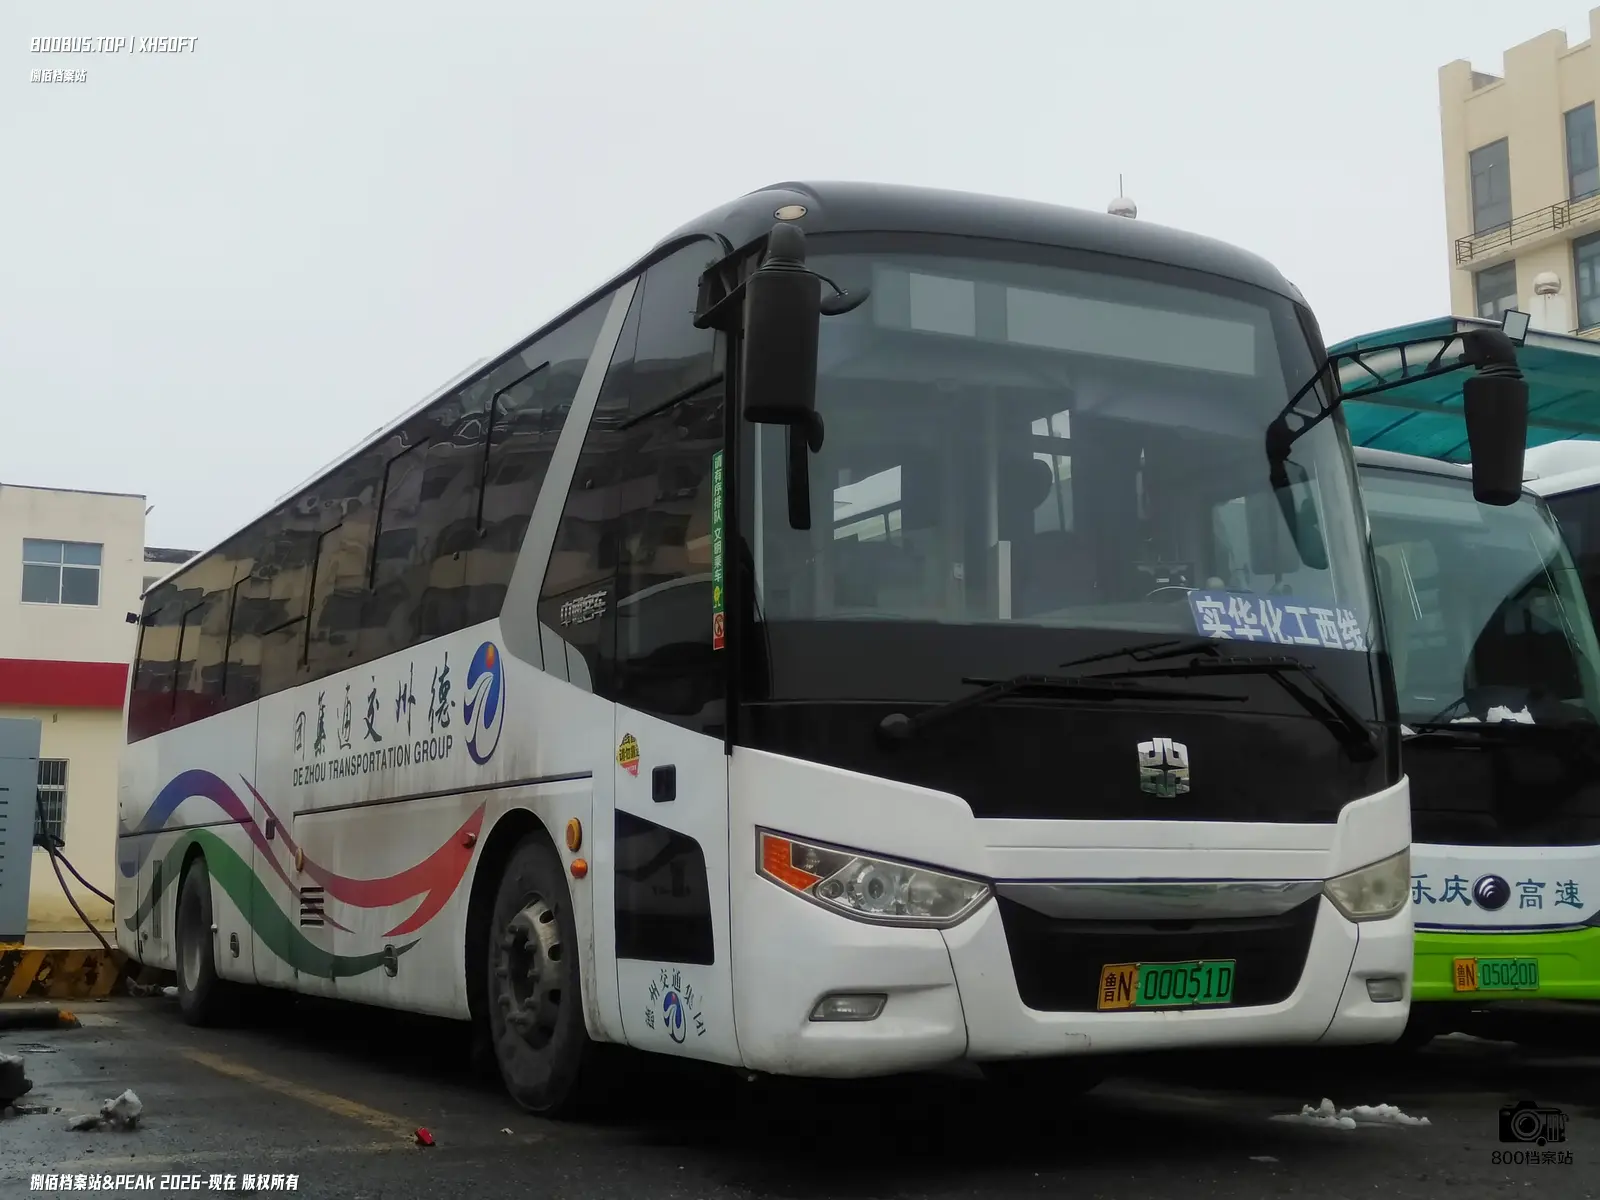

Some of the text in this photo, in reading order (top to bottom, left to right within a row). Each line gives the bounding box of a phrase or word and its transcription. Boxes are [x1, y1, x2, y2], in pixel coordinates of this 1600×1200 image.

[1195, 595, 1368, 652] 实华化工西线
[328, 744, 411, 780] TRANSPORTATION
[414, 735, 453, 764] GROUP
[1515, 878, 1584, 910] 高速
